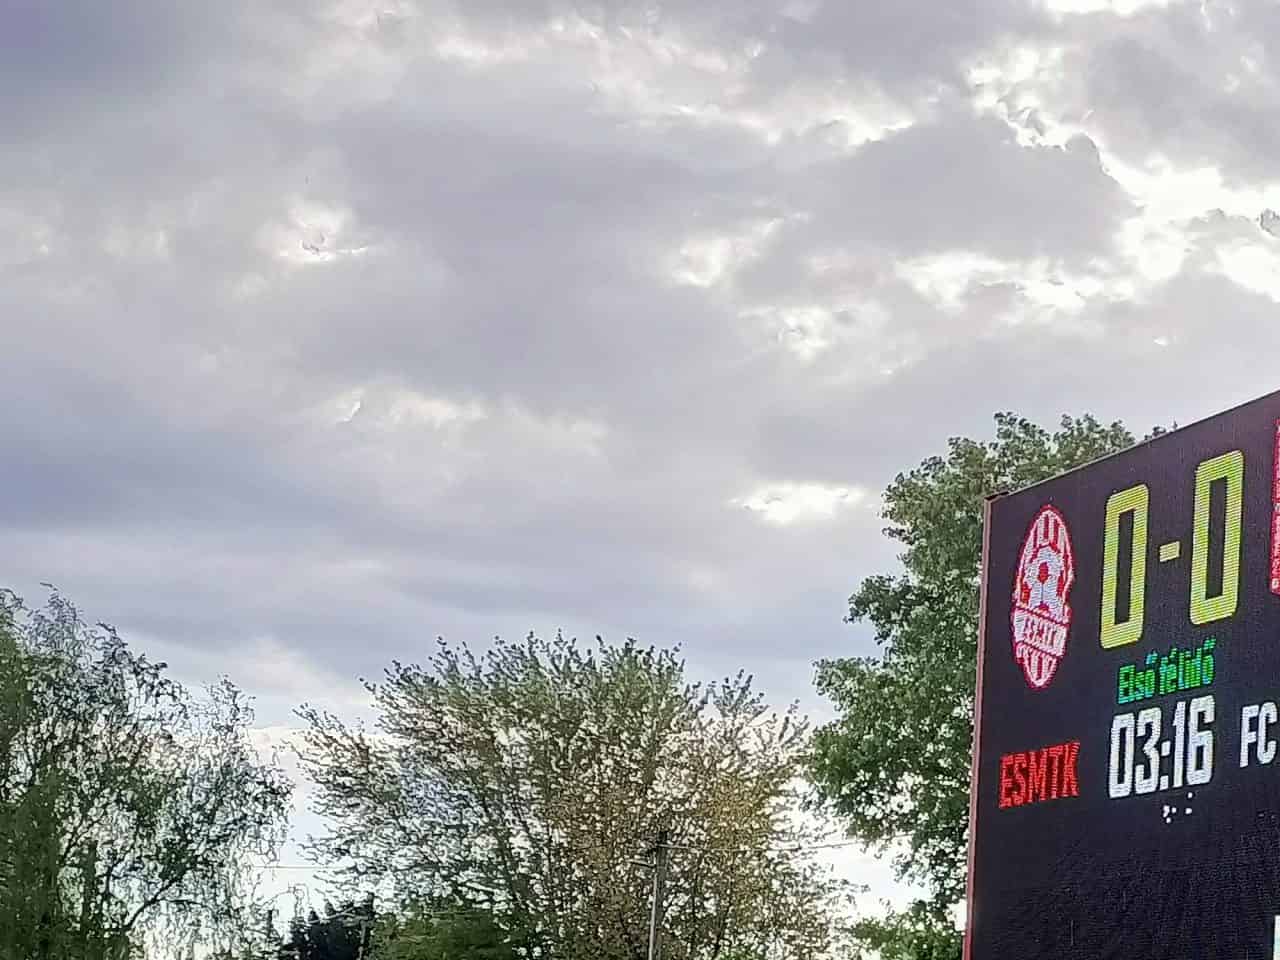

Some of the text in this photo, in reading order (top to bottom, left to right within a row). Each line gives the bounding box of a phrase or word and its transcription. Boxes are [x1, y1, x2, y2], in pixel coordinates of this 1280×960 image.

[1108, 694, 1216, 799] 03:16
[1239, 701, 1277, 768] FC
[999, 741, 1081, 809] ESMTK
